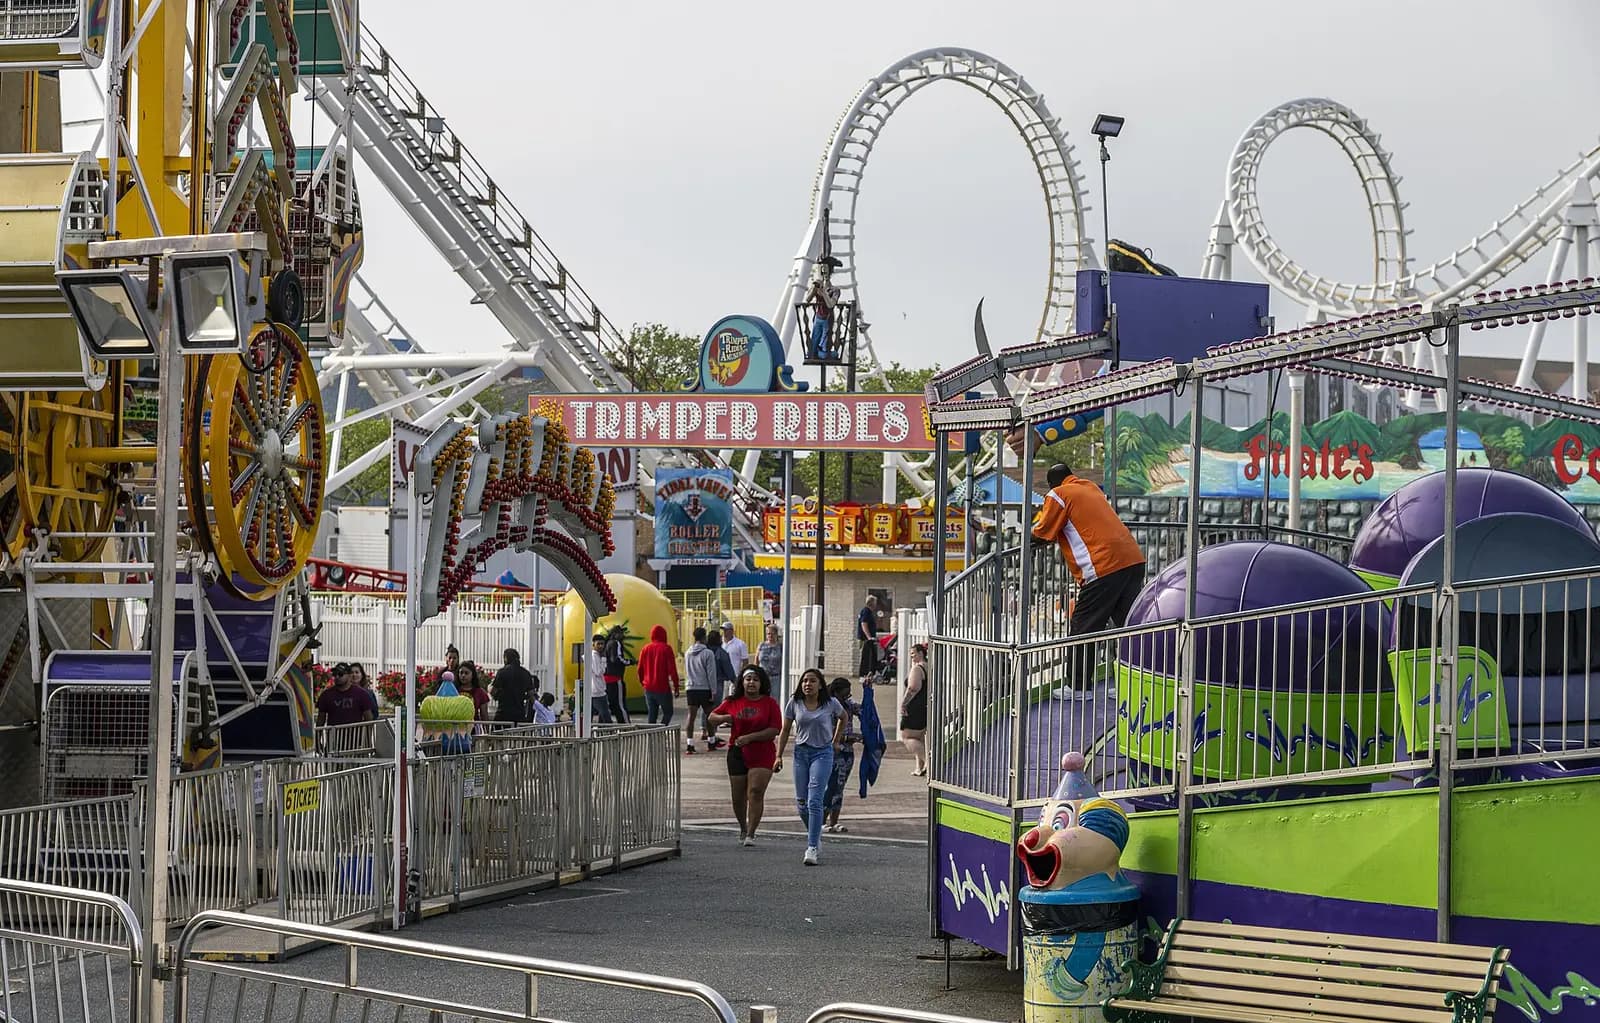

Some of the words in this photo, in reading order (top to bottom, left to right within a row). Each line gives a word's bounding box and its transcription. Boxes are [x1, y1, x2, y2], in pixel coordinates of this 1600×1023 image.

[568, 401, 758, 441] TRIMPER
[773, 401, 909, 442] RIDES
[657, 477, 695, 501] TIDAL
[670, 524, 720, 538] ROLLER
[668, 541, 721, 556] COASTER
[285, 788, 293, 811] 6
